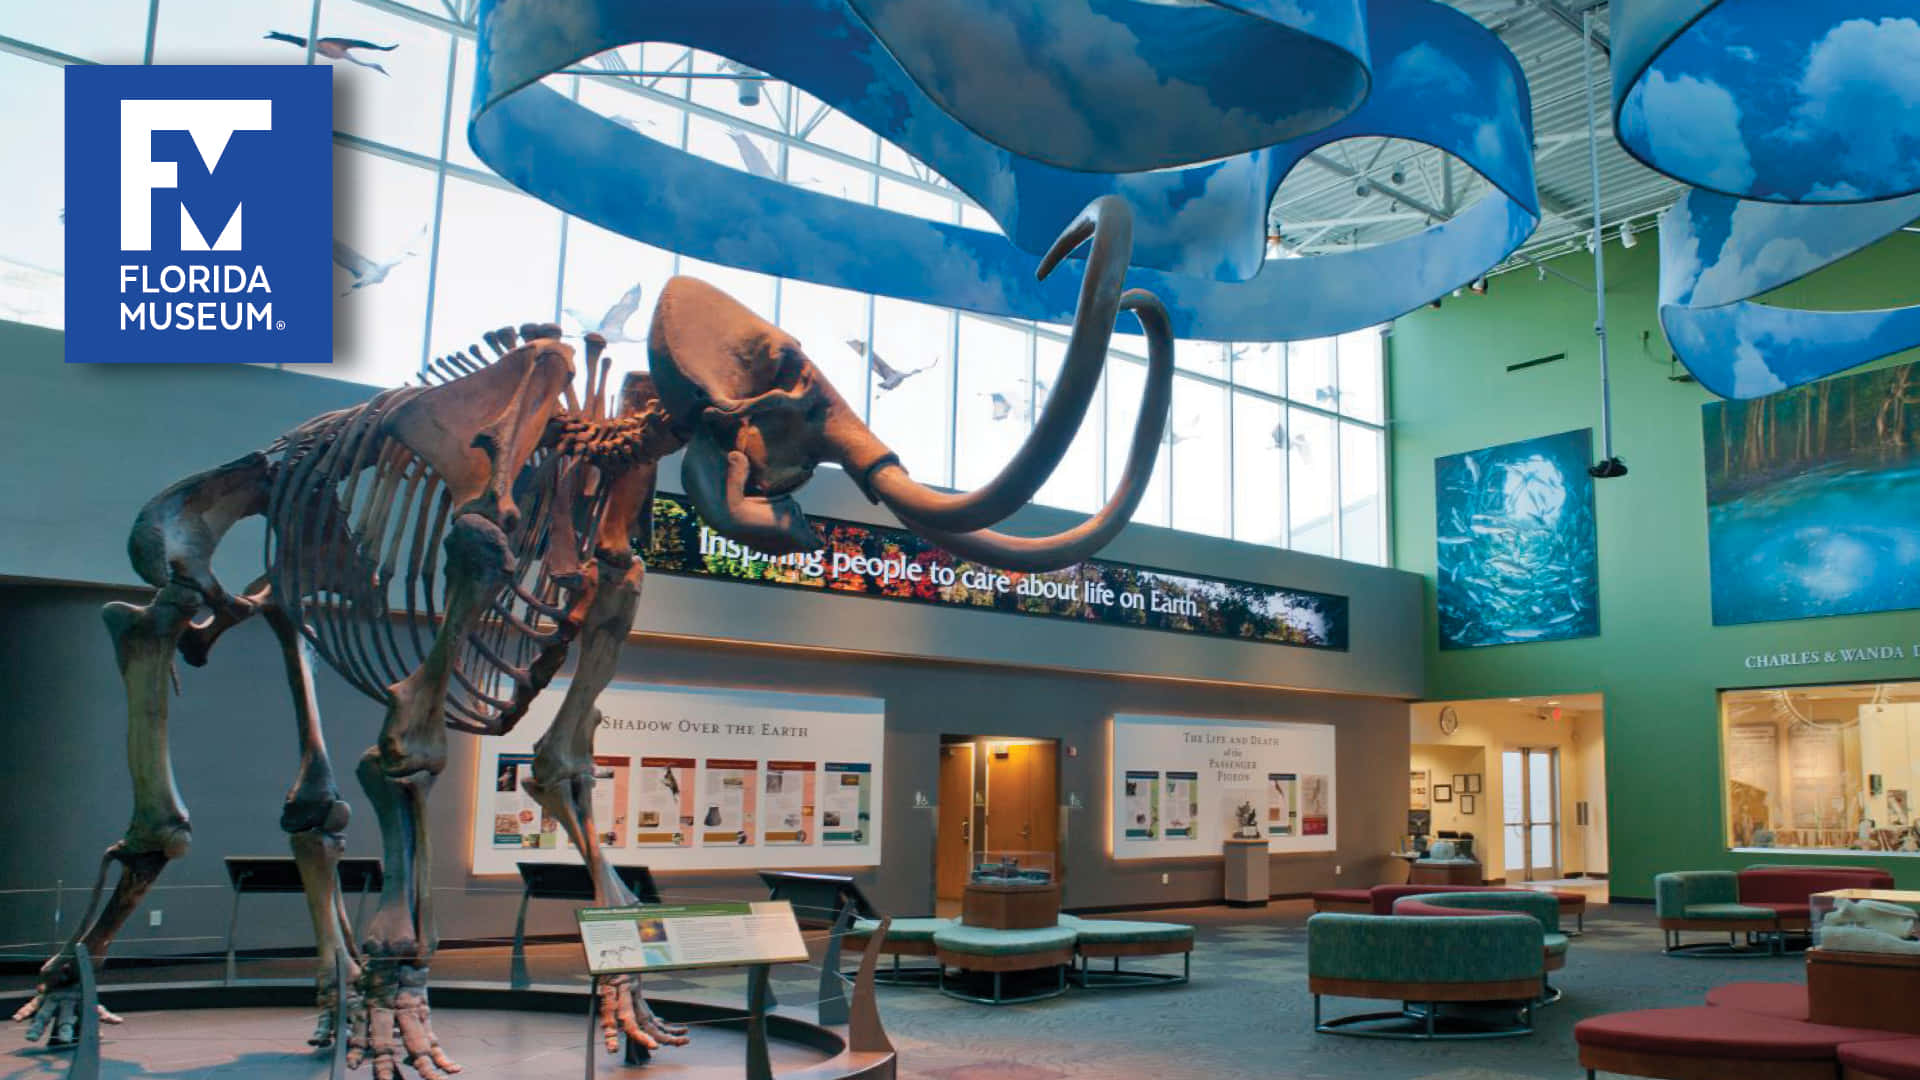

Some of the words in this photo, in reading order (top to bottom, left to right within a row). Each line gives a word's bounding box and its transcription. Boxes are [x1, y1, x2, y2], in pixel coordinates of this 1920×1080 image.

[832, 553, 922, 583] people
[929, 561, 956, 586] to
[962, 569, 1011, 594] care
[1016, 574, 1079, 601] about
[1085, 581, 1115, 607] life
[1120, 592, 1145, 610] on
[1151, 590, 1203, 617] Earth.
[1744, 651, 1820, 669] CHARLES
[1823, 650, 1838, 663] &
[1840, 647, 1904, 661] WANDA
[601, 716, 674, 732] SHADOW
[678, 719, 721, 735] OVER
[726, 723, 755, 736] THE
[761, 722, 809, 738] EARTH
